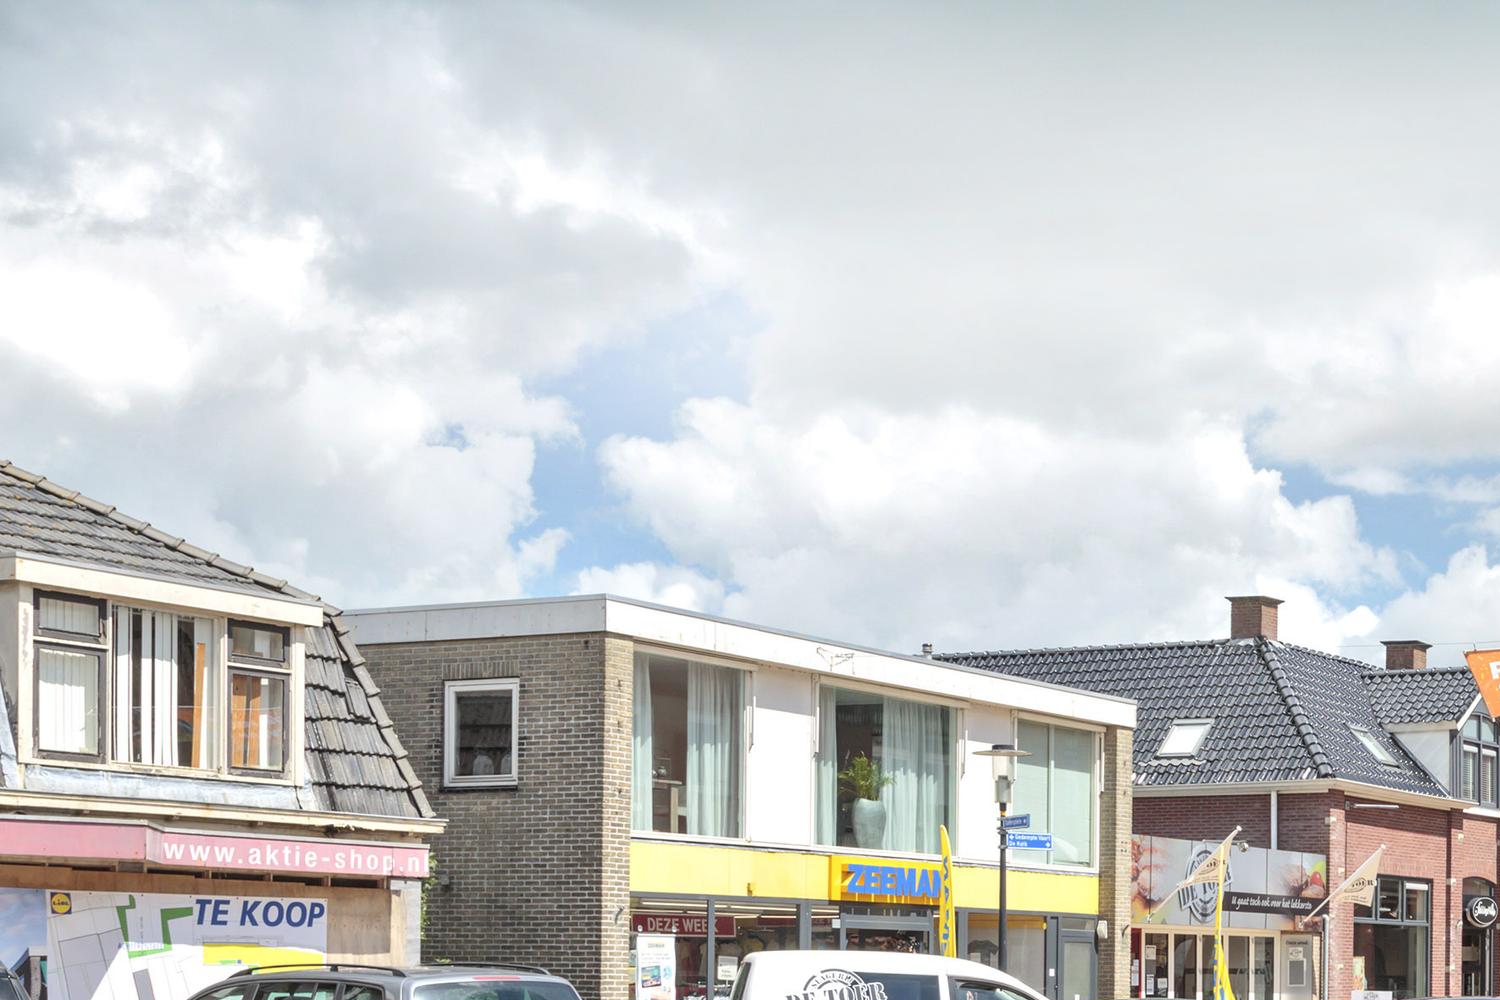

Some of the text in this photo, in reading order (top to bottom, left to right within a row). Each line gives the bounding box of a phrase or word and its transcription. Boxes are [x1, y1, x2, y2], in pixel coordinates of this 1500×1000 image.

[164, 843, 429, 875] www.aktie-shop.nl
[195, 899, 325, 928] TE KOOP
[647, 917, 680, 931] DEZE
